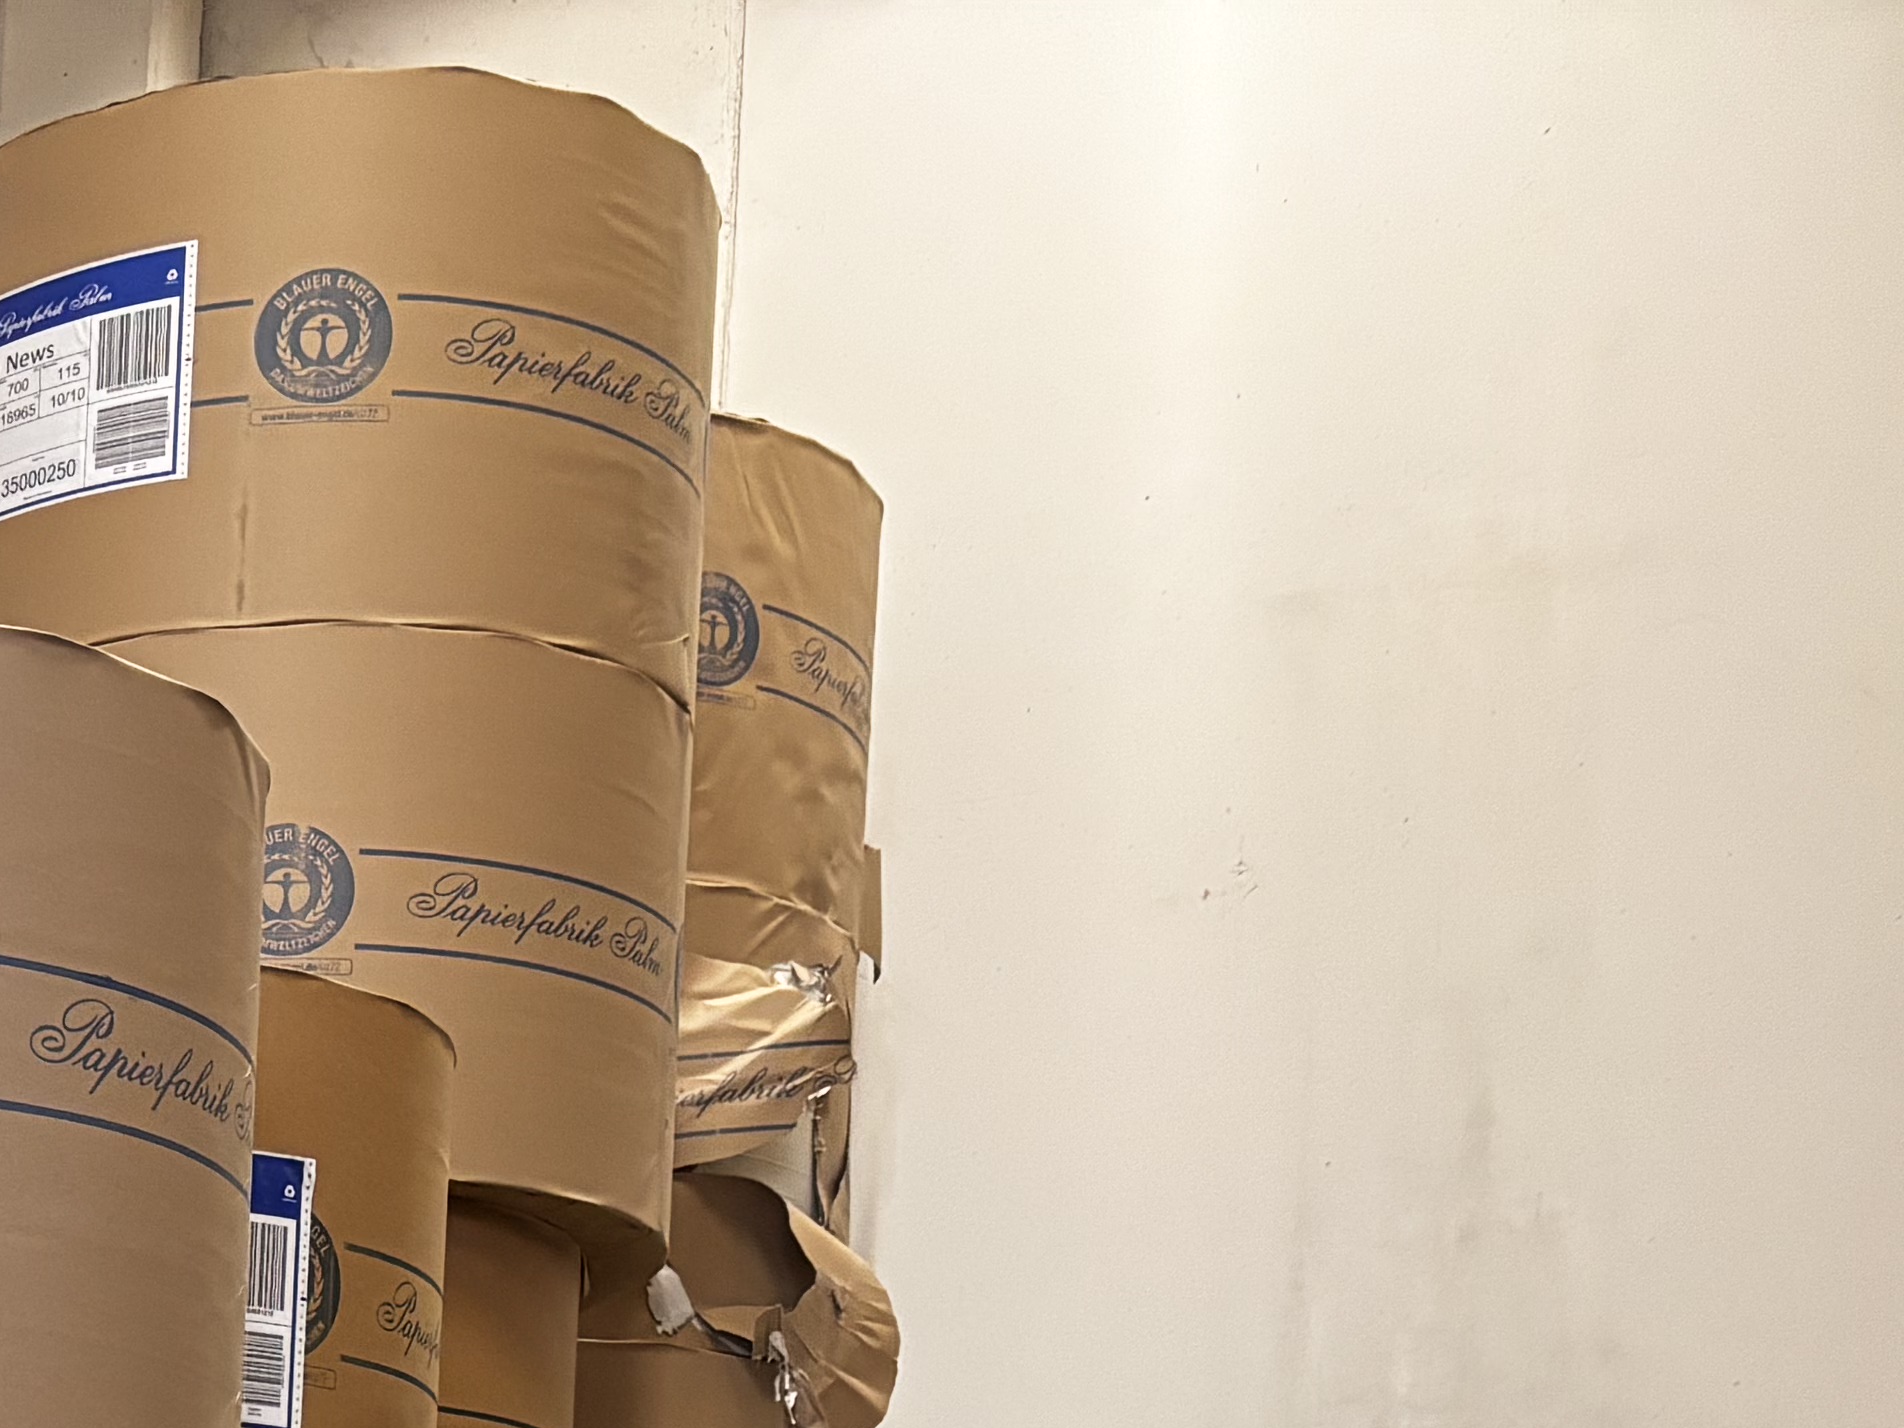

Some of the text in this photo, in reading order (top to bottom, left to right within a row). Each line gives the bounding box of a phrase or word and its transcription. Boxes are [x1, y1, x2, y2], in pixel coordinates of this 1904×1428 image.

[273, 273, 379, 311] BLAUER ENGEL
[6, 343, 55, 372] News
[445, 318, 636, 405] Papierfabrik
[7, 378, 30, 397] 700
[57, 362, 81, 380] 115
[51, 387, 86, 408] 10/10
[0, 458, 77, 498] 35000250
[407, 872, 663, 977] Papierfabrik Palm
[29, 998, 235, 1123] Papierfabrik
